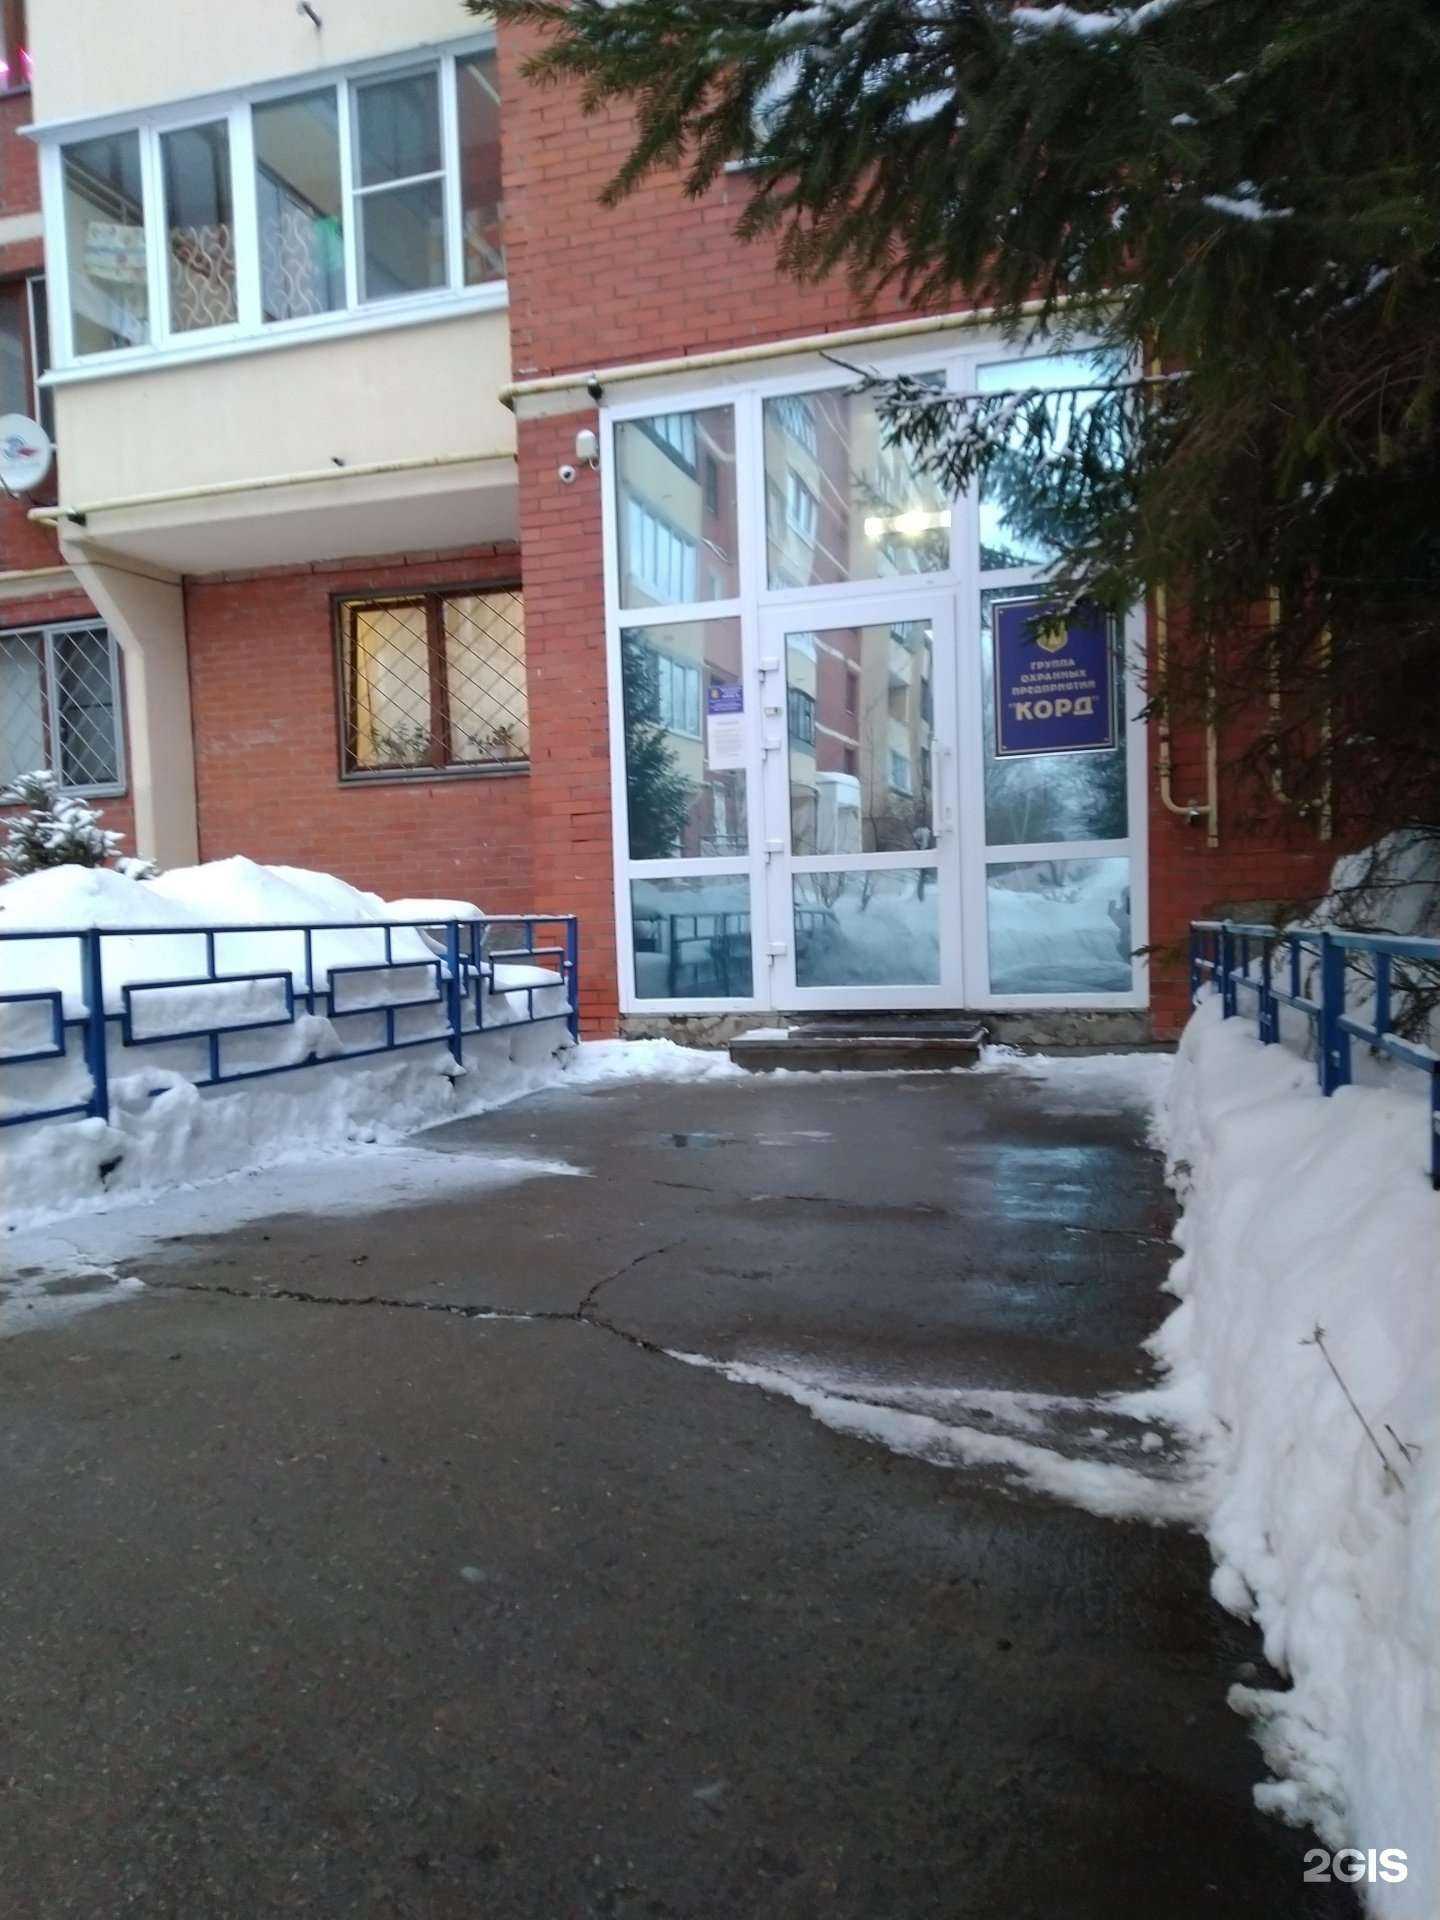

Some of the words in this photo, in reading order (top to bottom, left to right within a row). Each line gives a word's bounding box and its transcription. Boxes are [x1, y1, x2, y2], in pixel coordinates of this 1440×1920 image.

[1030, 659, 1075, 670] ГРУППА
[1021, 670, 1087, 682] ОХРАННЫХ
[1008, 696, 1099, 720] "КОРД"
